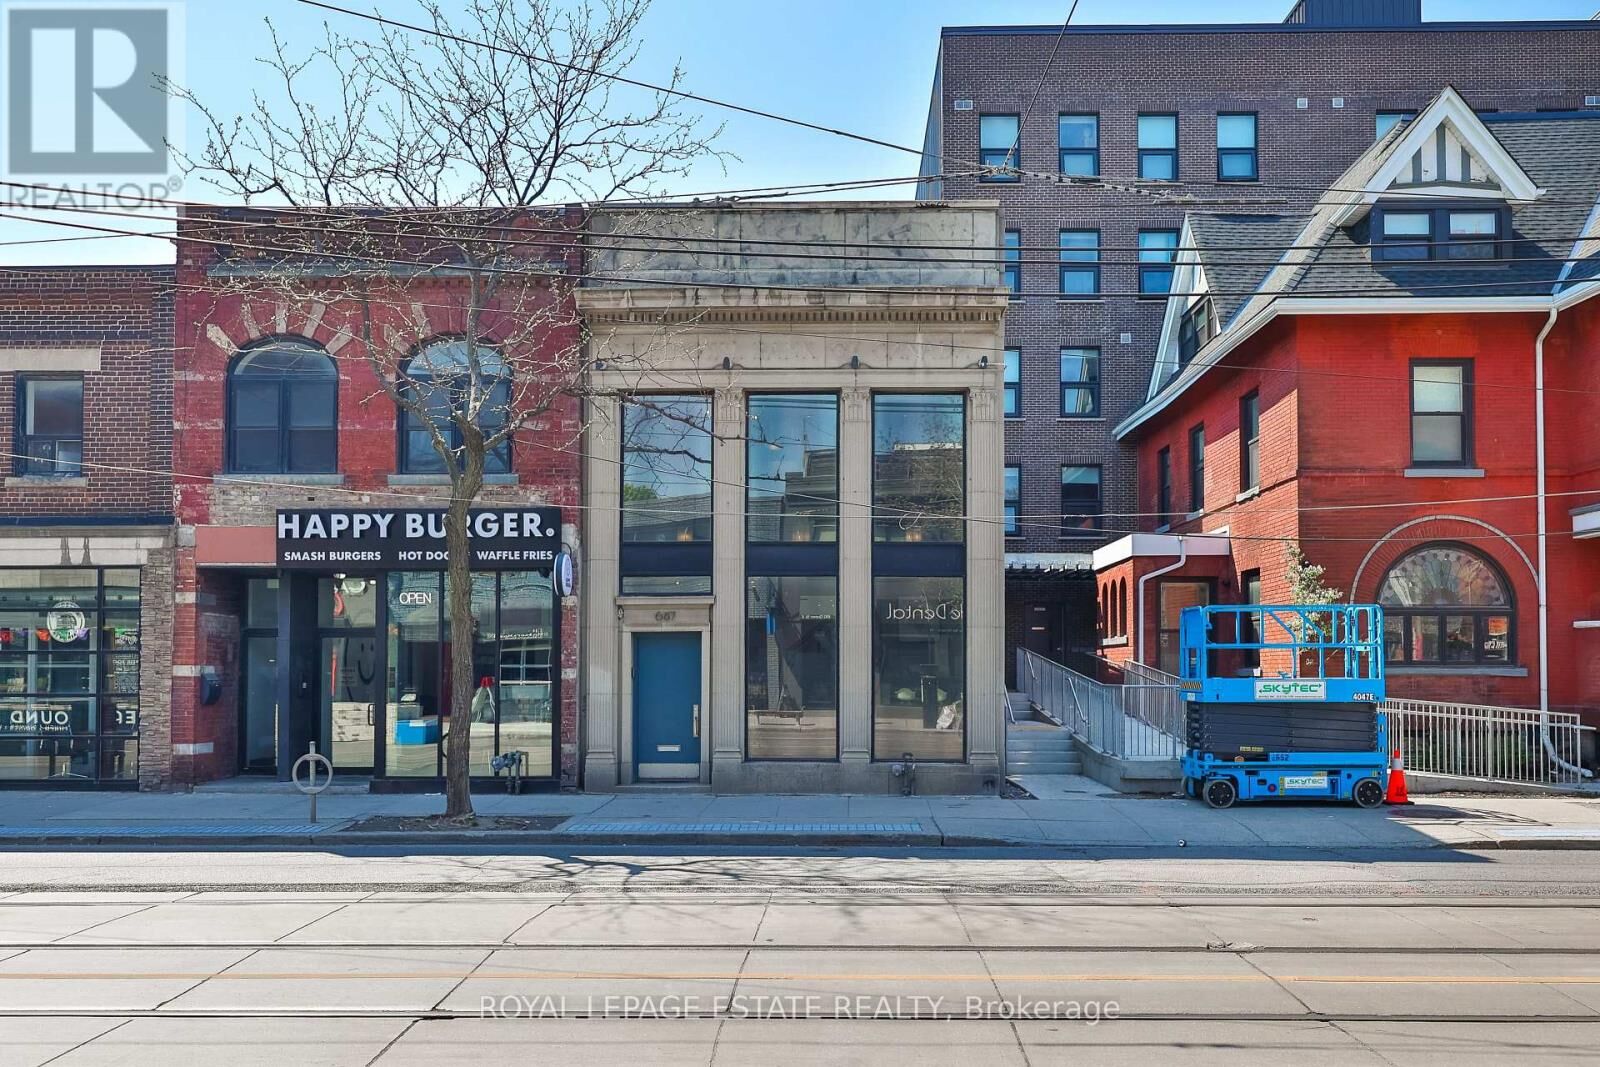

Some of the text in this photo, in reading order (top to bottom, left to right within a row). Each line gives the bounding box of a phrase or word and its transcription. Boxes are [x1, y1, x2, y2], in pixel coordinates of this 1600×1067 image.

[278, 514, 395, 539] HAPPY
[284, 551, 326, 561] SMASH
[329, 551, 382, 561] BURGERS
[398, 551, 423, 561] HOT
[476, 550, 521, 561] WAFFLE
[523, 550, 553, 560] FRIES
[399, 592, 432, 604] OPEN
[1261, 682, 1320, 695] SKYTEC
[1352, 692, 1374, 701] 4047E
